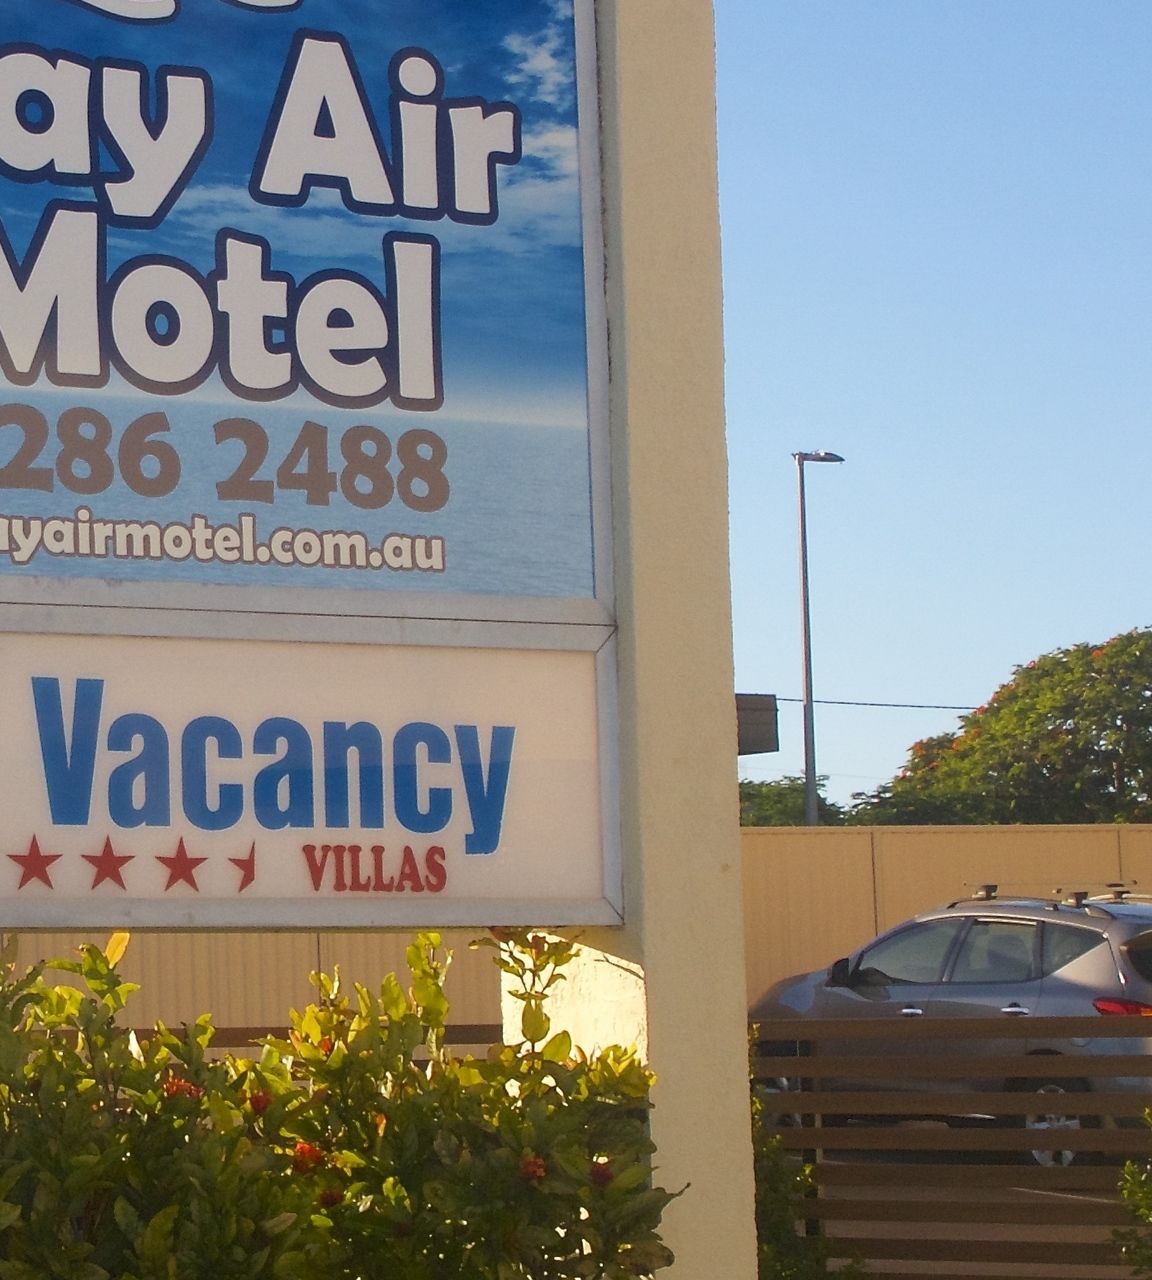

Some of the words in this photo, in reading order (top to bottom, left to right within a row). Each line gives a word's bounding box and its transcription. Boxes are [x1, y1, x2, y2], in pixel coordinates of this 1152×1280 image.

[255, 33, 519, 218] Air
[213, 418, 450, 514] 2488
[30, 676, 515, 856] Vacancy
[301, 843, 448, 894] VILLAS
